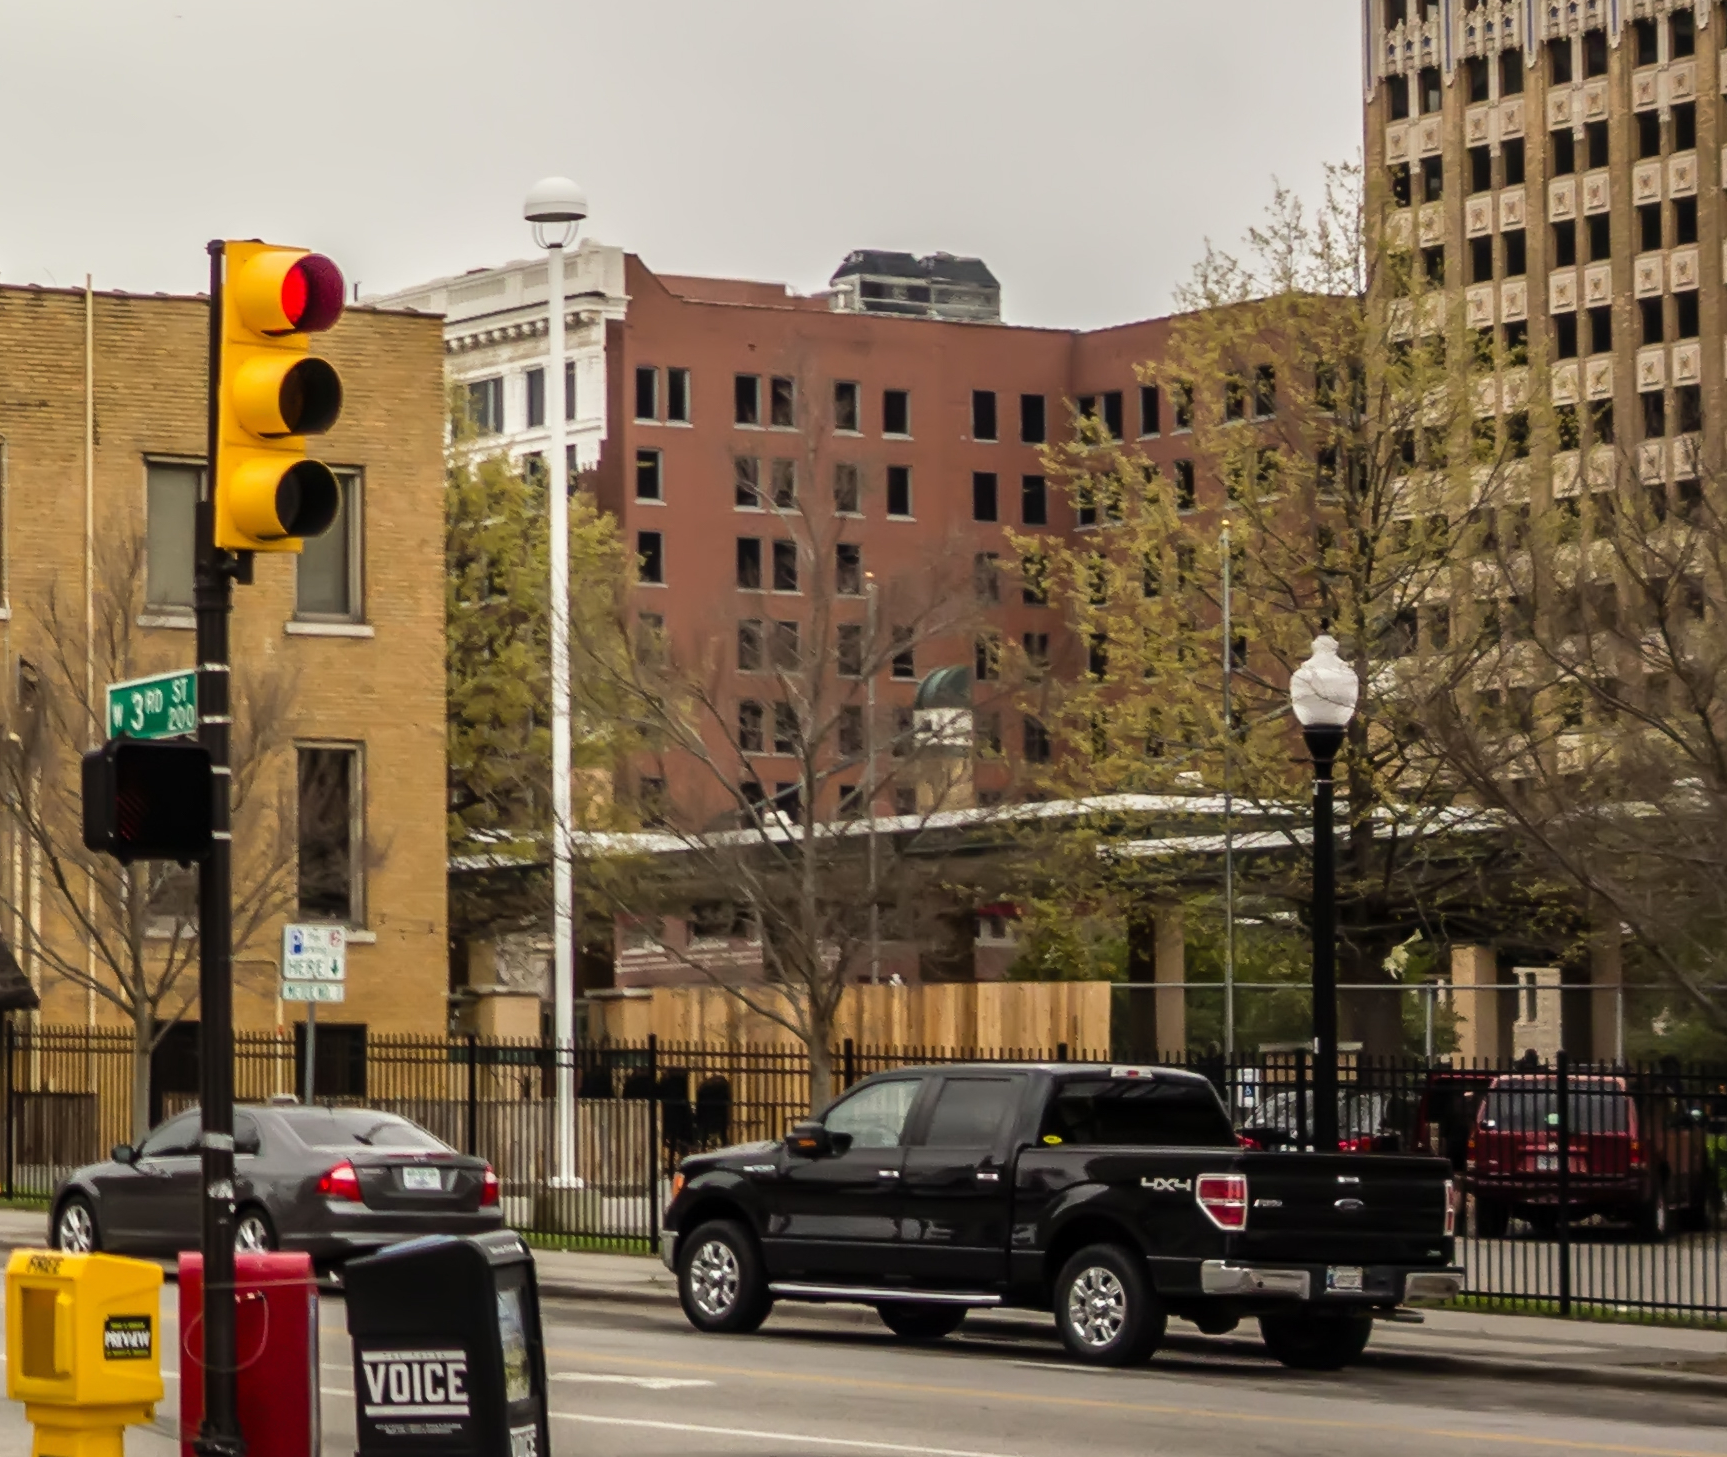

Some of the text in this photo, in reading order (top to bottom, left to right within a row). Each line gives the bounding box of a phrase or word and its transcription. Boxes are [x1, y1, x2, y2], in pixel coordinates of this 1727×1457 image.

[112, 702, 124, 728] W
[171, 677, 188, 704] ST
[168, 702, 195, 731] 200
[25, 1254, 64, 1274] FREE
[105, 1329, 150, 1348] PREVIEW
[362, 1361, 469, 1404] VOICE
